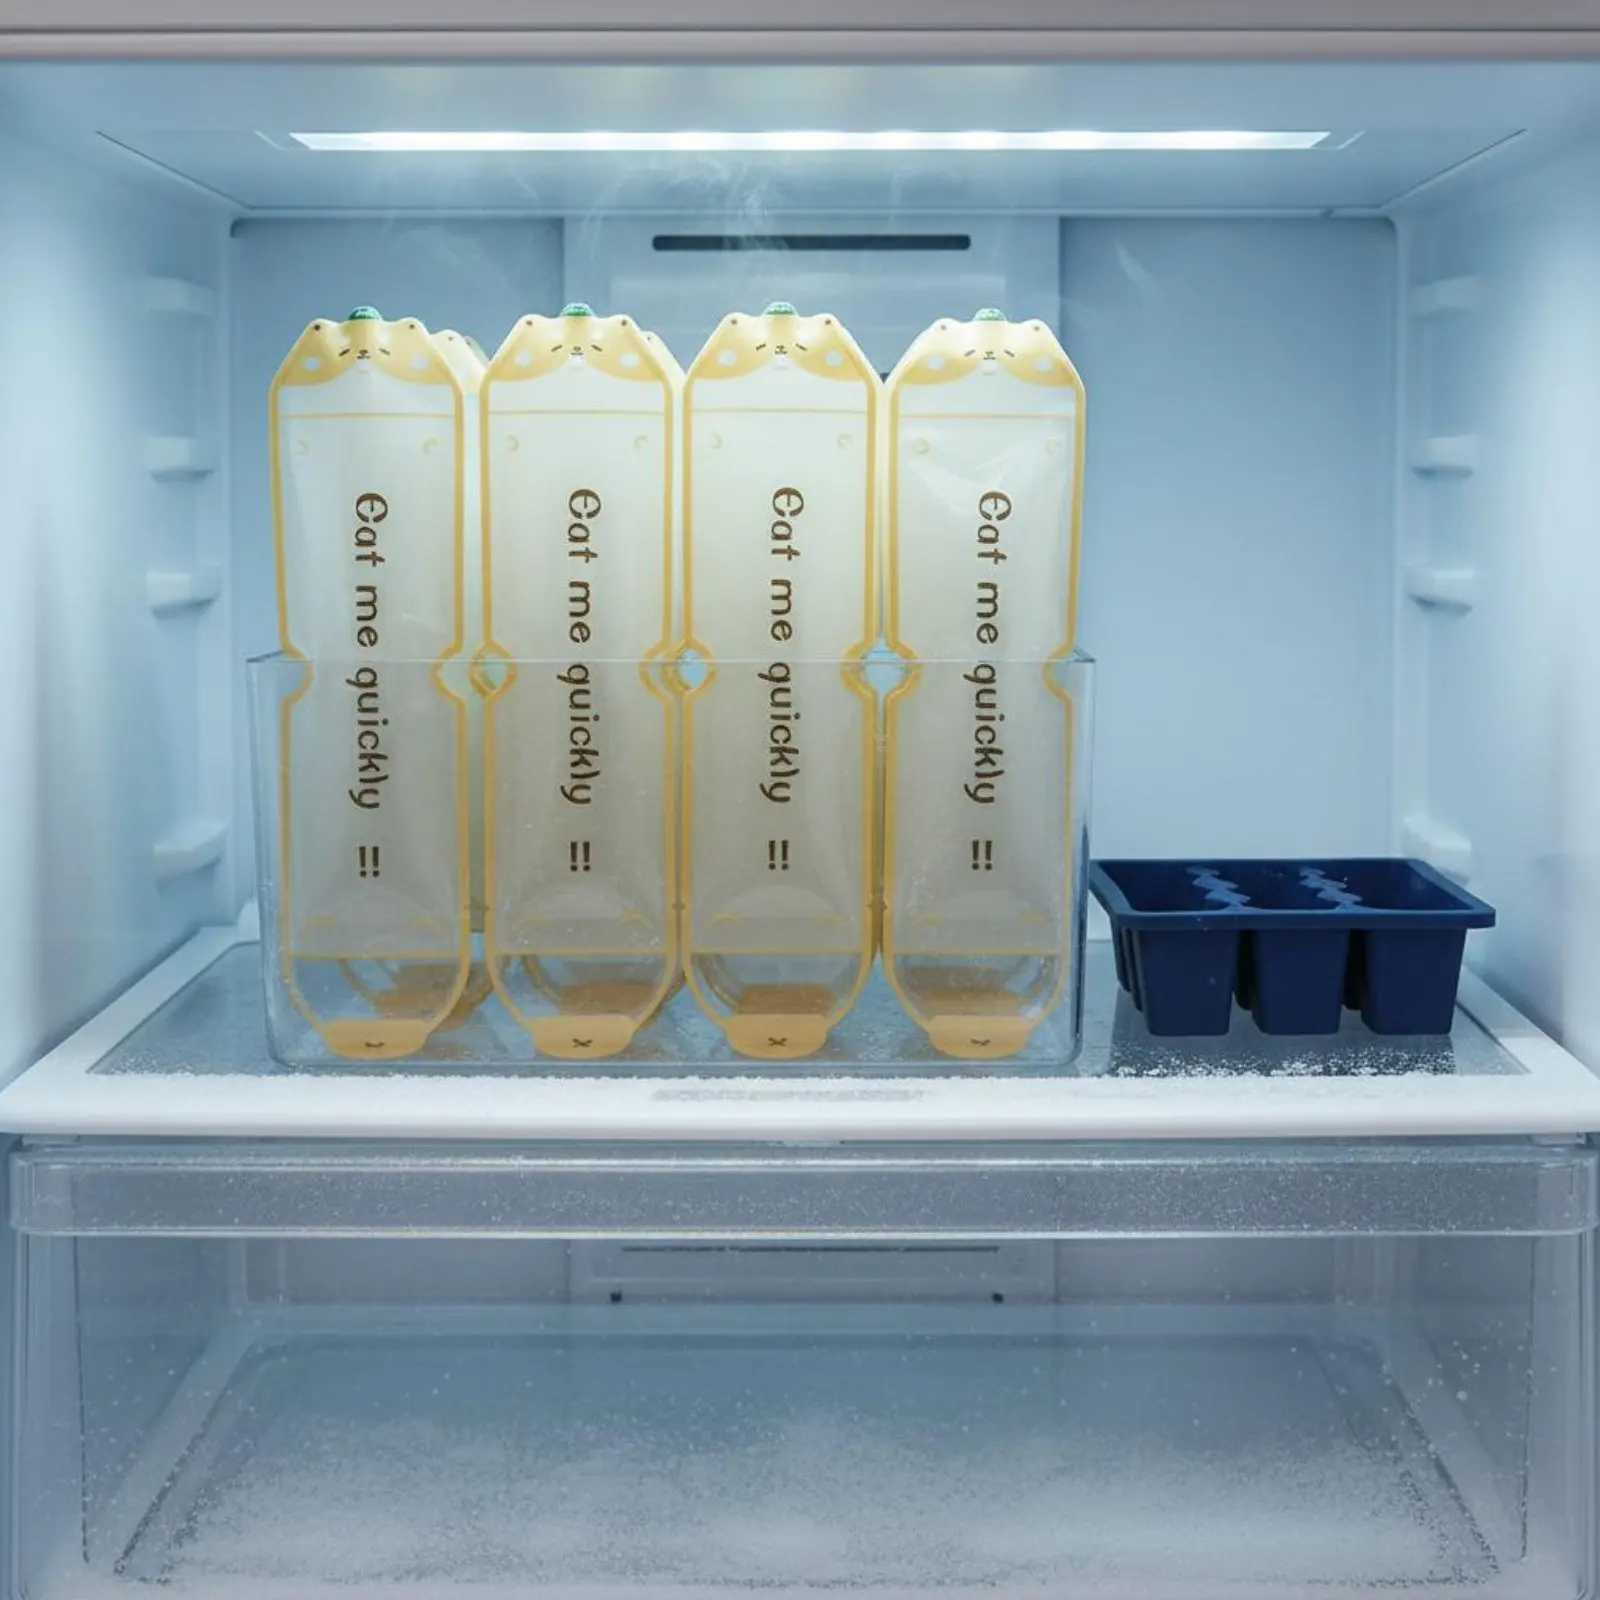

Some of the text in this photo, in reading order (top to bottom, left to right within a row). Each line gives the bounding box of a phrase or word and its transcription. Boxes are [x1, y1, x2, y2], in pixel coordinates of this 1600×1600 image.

[354, 492, 389, 568] Eat
[567, 489, 601, 564] Eat
[771, 487, 804, 561] Eat
[977, 492, 1012, 565] Eat
[355, 585, 379, 648] me
[568, 580, 592, 644] me
[770, 579, 793, 642] me
[976, 582, 999, 645] me
[345, 666, 391, 810] quickly
[556, 662, 602, 806] quickly
[756, 661, 801, 804] quickly
[962, 663, 1006, 805] quickly
